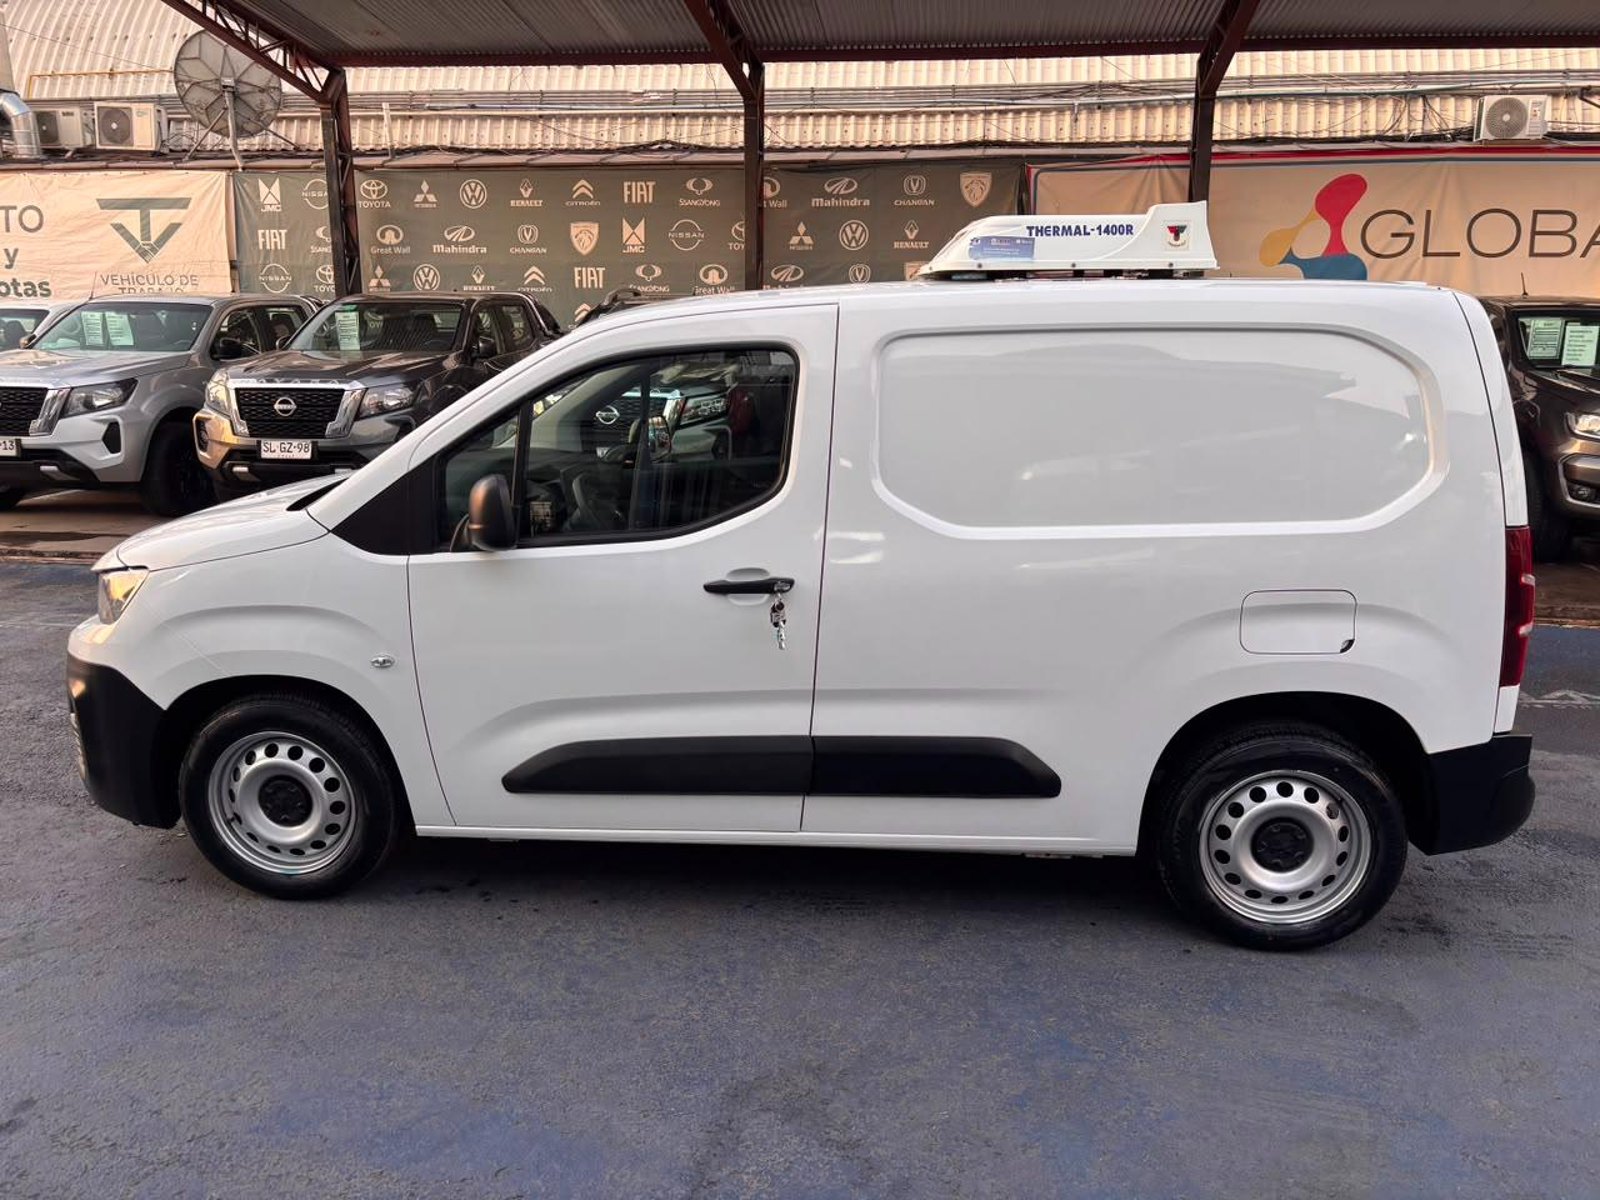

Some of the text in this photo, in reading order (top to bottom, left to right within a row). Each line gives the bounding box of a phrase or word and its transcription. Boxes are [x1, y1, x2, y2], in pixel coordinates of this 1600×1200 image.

[623, 181, 656, 204] FIAT
[261, 204, 282, 212] JMC
[769, 200, 788, 208] Wall
[811, 198, 870, 208] Mahindra
[0, 205, 44, 233] TO
[1026, 224, 1134, 236] THERMAL-1400R
[258, 229, 288, 250] FIAT
[894, 241, 929, 249] RENAULT
[432, 245, 487, 254] Mahindra
[622, 245, 645, 253] JMC
[3, 248, 19, 269] y
[179, 274, 199, 286] DE
[574, 266, 606, 288] FIAT
